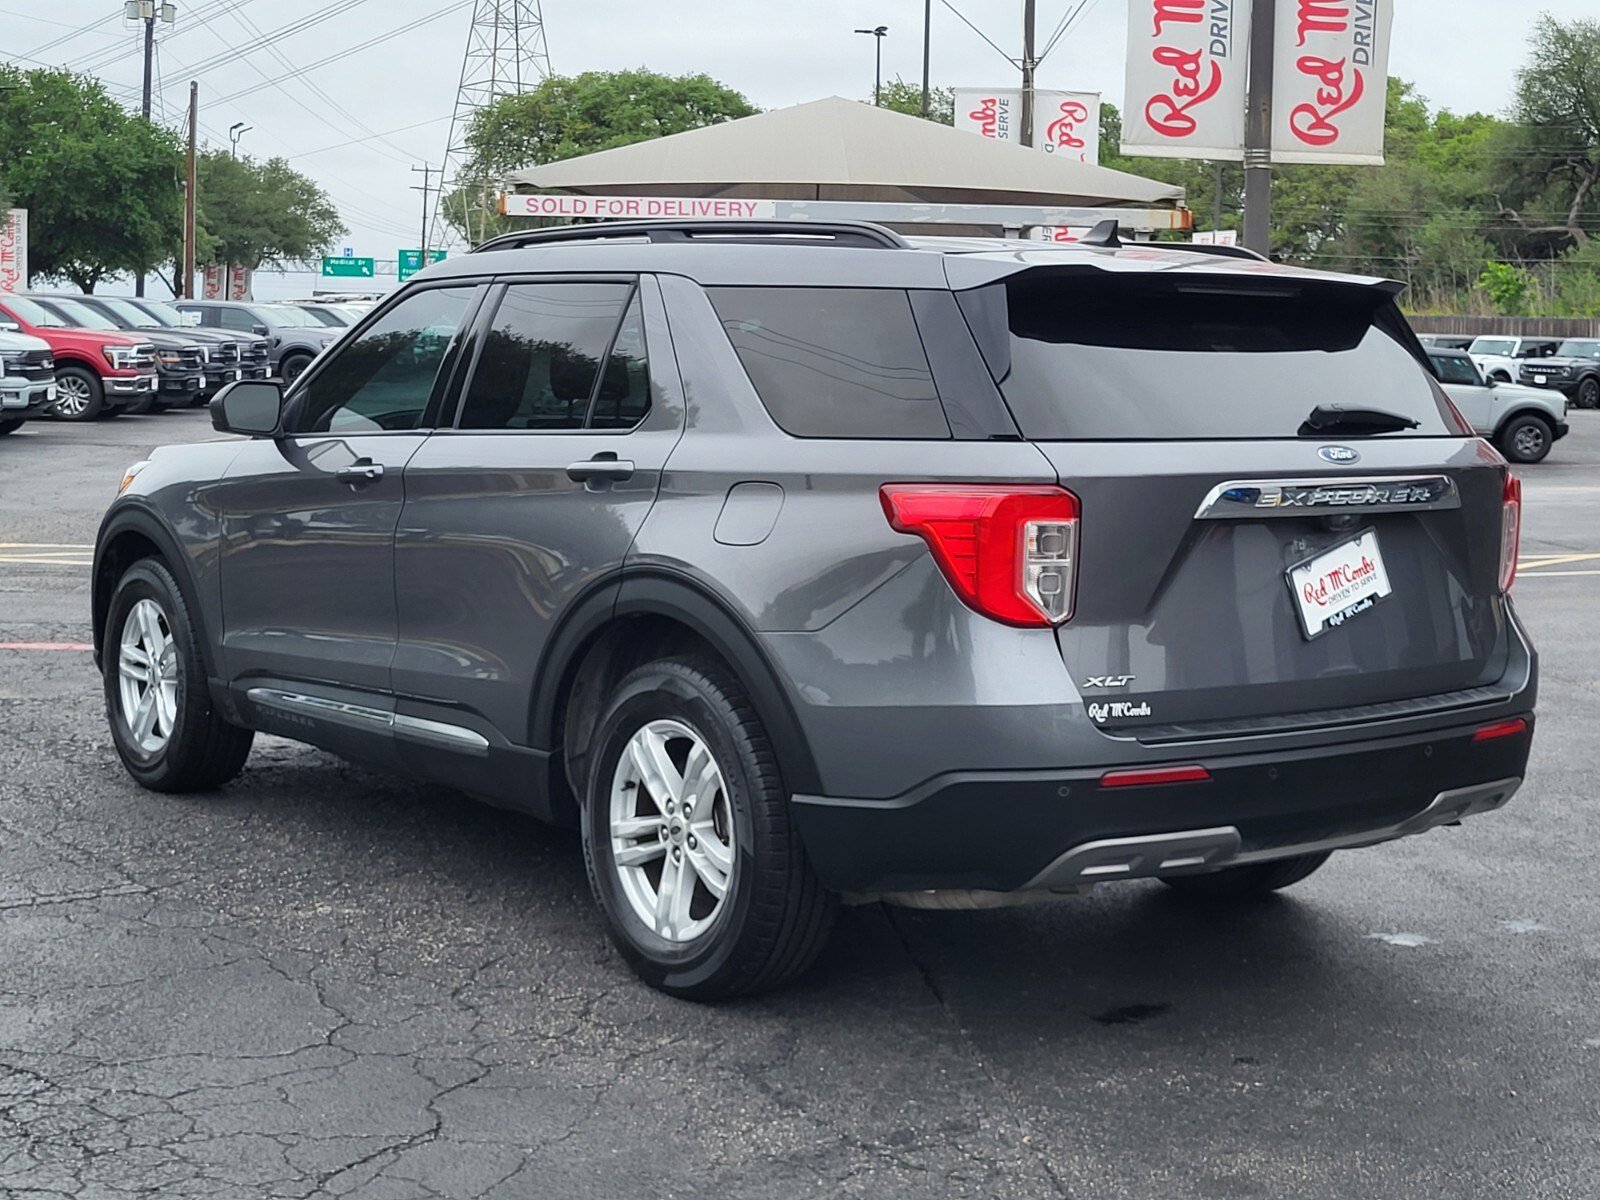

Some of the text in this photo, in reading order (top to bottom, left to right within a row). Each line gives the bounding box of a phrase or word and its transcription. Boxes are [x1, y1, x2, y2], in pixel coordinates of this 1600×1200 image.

[1145, 46, 1222, 138] Red
[1289, 56, 1364, 146] Red
[998, 98, 1009, 139] SERVE
[1047, 101, 1088, 149] Red
[526, 197, 758, 217] SOLD FOR DELIVERY
[330, 258, 355, 266] Medical
[1329, 447, 1354, 459] Ford
[1254, 485, 1432, 508] EXPLORER
[1303, 556, 1375, 606] Red McCombs
[1328, 573, 1377, 605] DRIVEN TO SERVE
[1329, 611, 1345, 626] Red
[1082, 675, 1136, 688] XLT
[1088, 701, 1151, 723] Red McCombs
